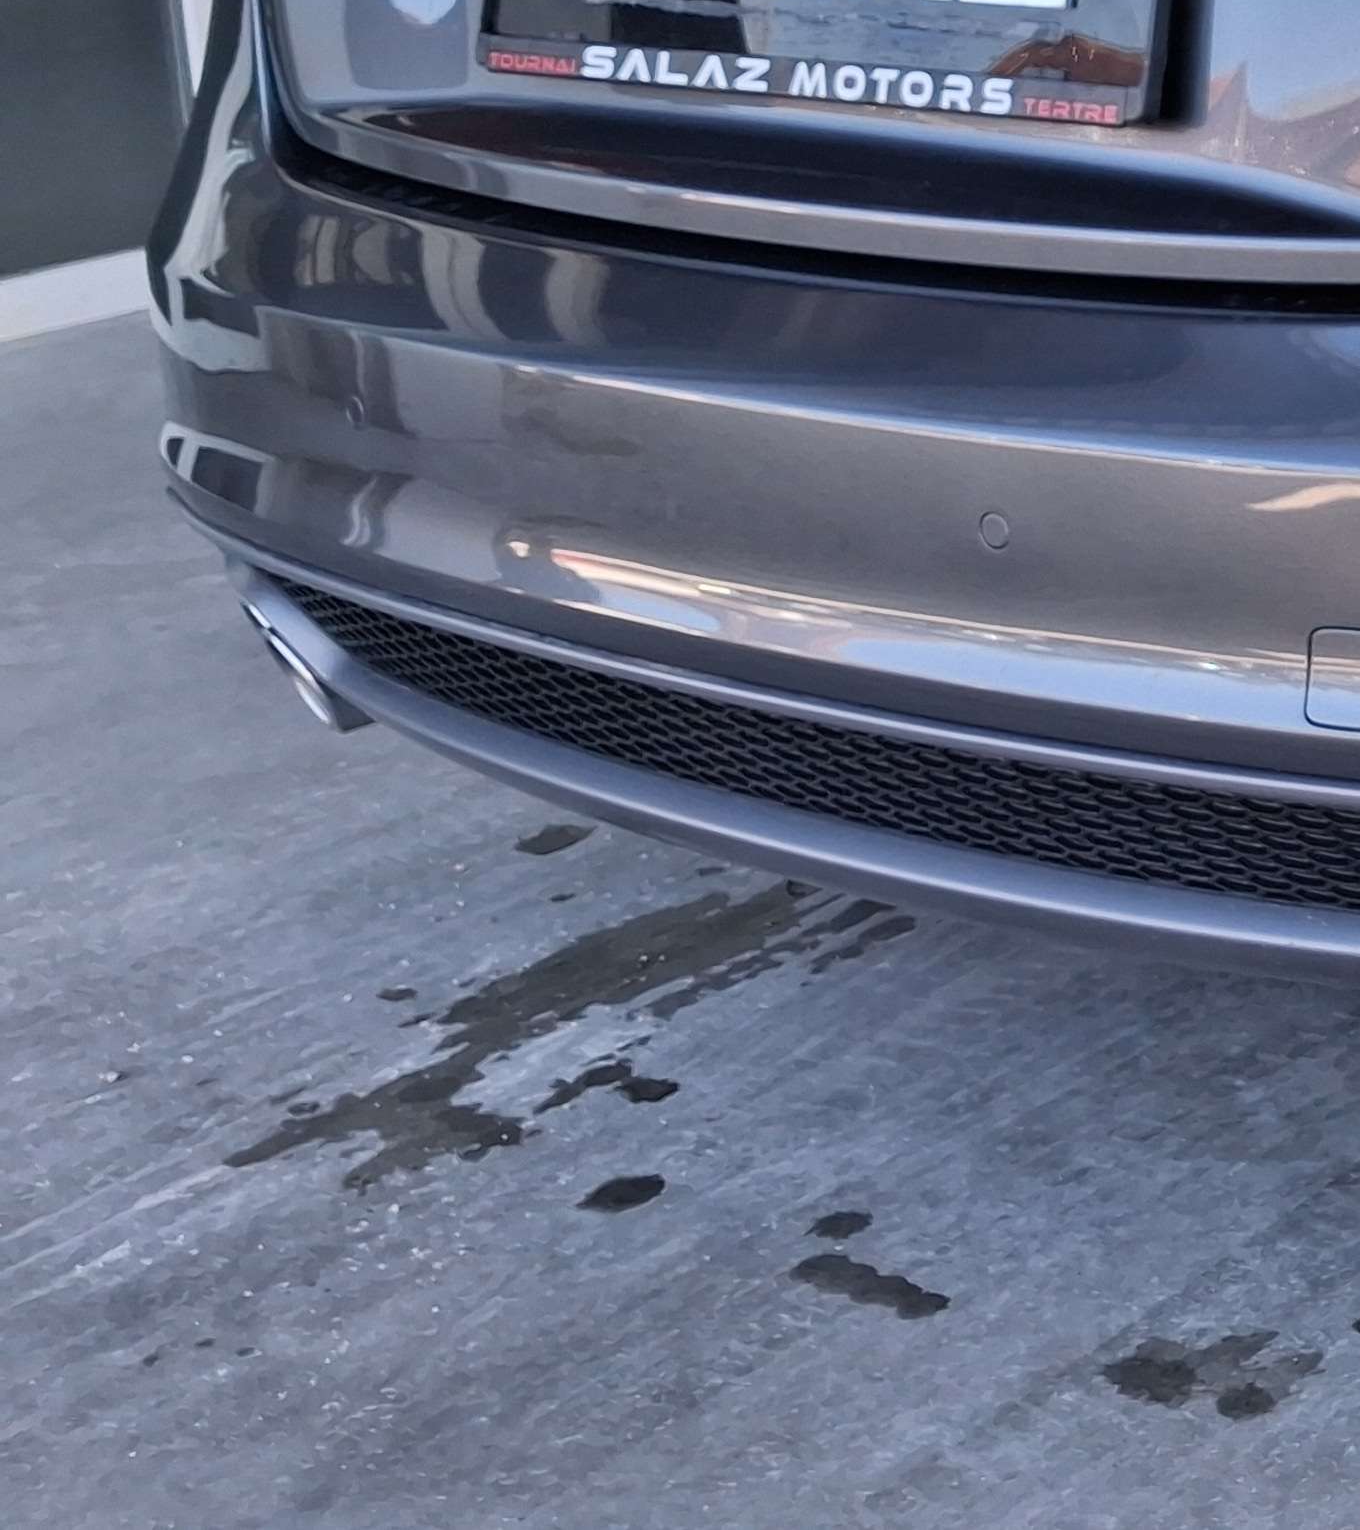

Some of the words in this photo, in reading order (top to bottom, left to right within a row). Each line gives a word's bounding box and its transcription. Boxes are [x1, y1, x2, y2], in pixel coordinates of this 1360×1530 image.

[488, 51, 577, 75] TOURNAI
[580, 45, 771, 93] SALAZ
[788, 61, 1015, 115] MOTORS
[1023, 96, 1119, 125] TERTRE
